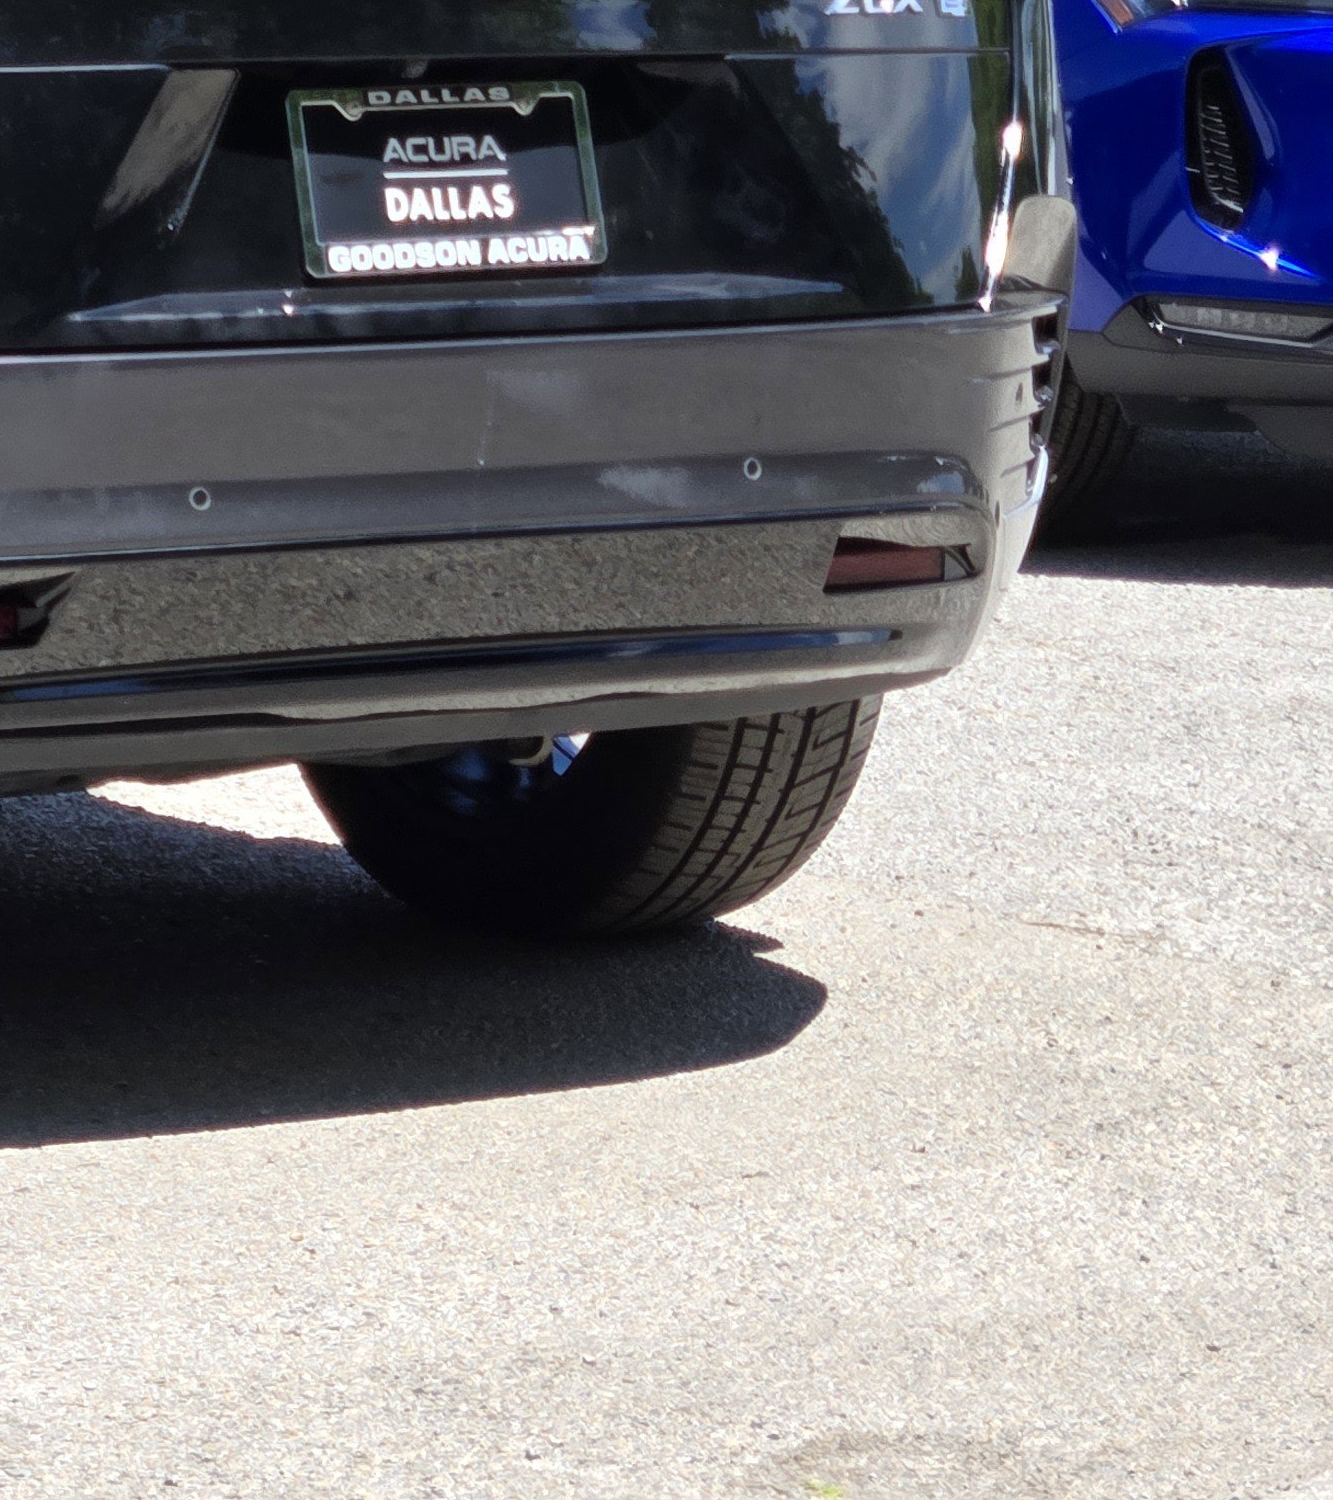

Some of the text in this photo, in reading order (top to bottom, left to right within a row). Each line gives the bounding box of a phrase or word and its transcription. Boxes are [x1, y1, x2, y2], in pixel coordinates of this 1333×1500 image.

[367, 86, 510, 106] DALLAS
[383, 134, 507, 163] ACURA
[384, 183, 515, 223] DALLAS
[328, 234, 591, 272] GOODSON ACURA
